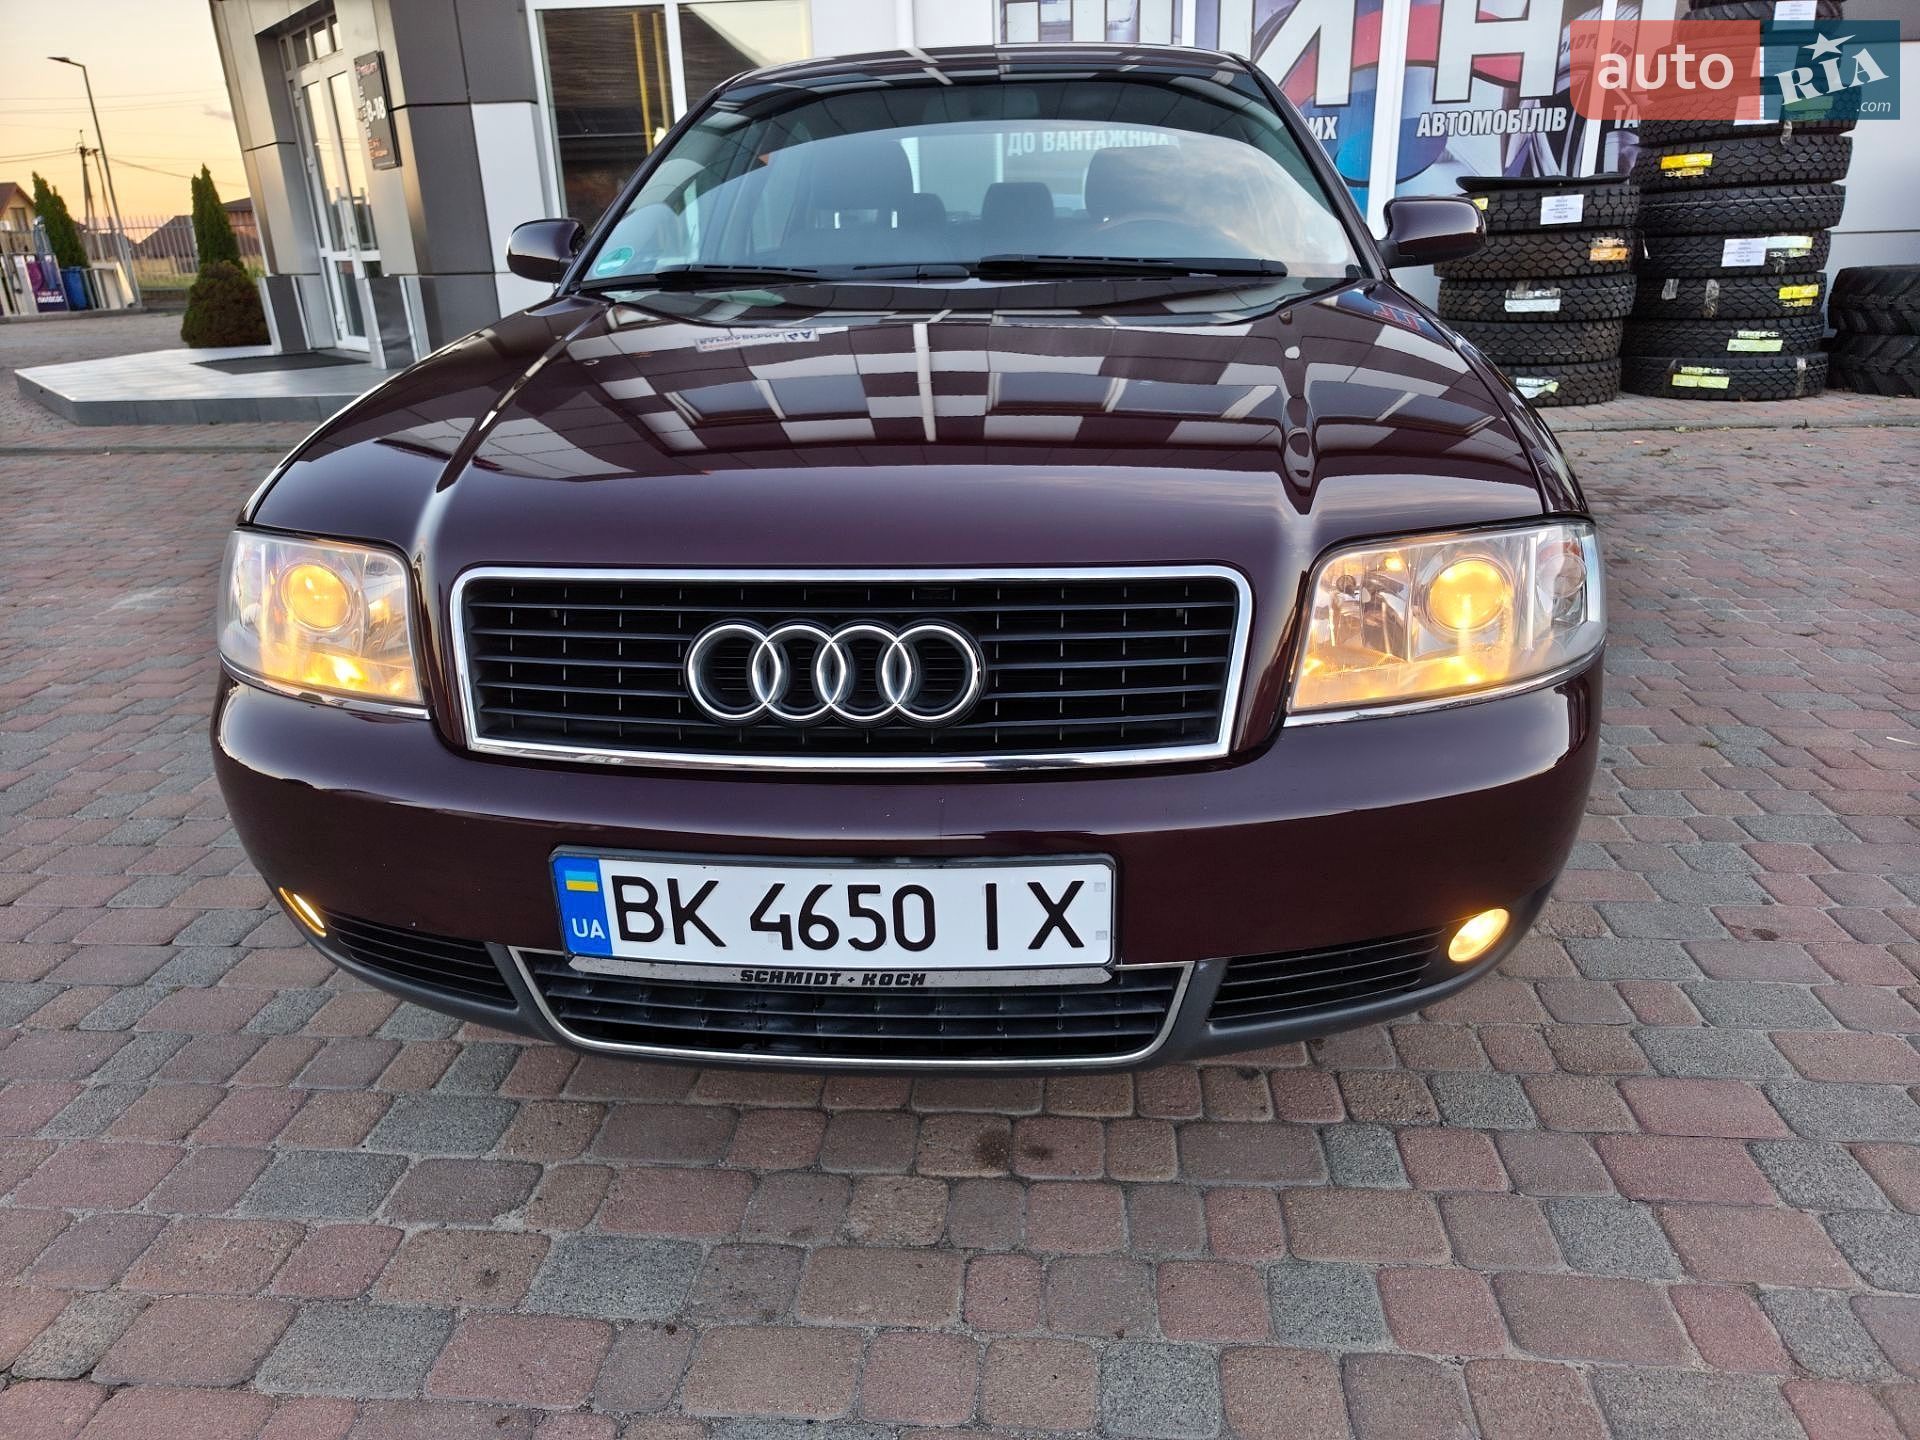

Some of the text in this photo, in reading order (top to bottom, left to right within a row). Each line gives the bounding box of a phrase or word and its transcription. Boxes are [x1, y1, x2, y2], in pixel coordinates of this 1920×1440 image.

[1007, 132, 1034, 157] ДО
[1416, 107, 1567, 138] АВТОМОБІЛІВ
[1613, 103, 1639, 129] ТА
[571, 917, 606, 940] UA
[611, 875, 1086, 951] BK 4650 IX
[739, 969, 841, 986] SCHMIDT
[861, 972, 927, 987] KOCH
